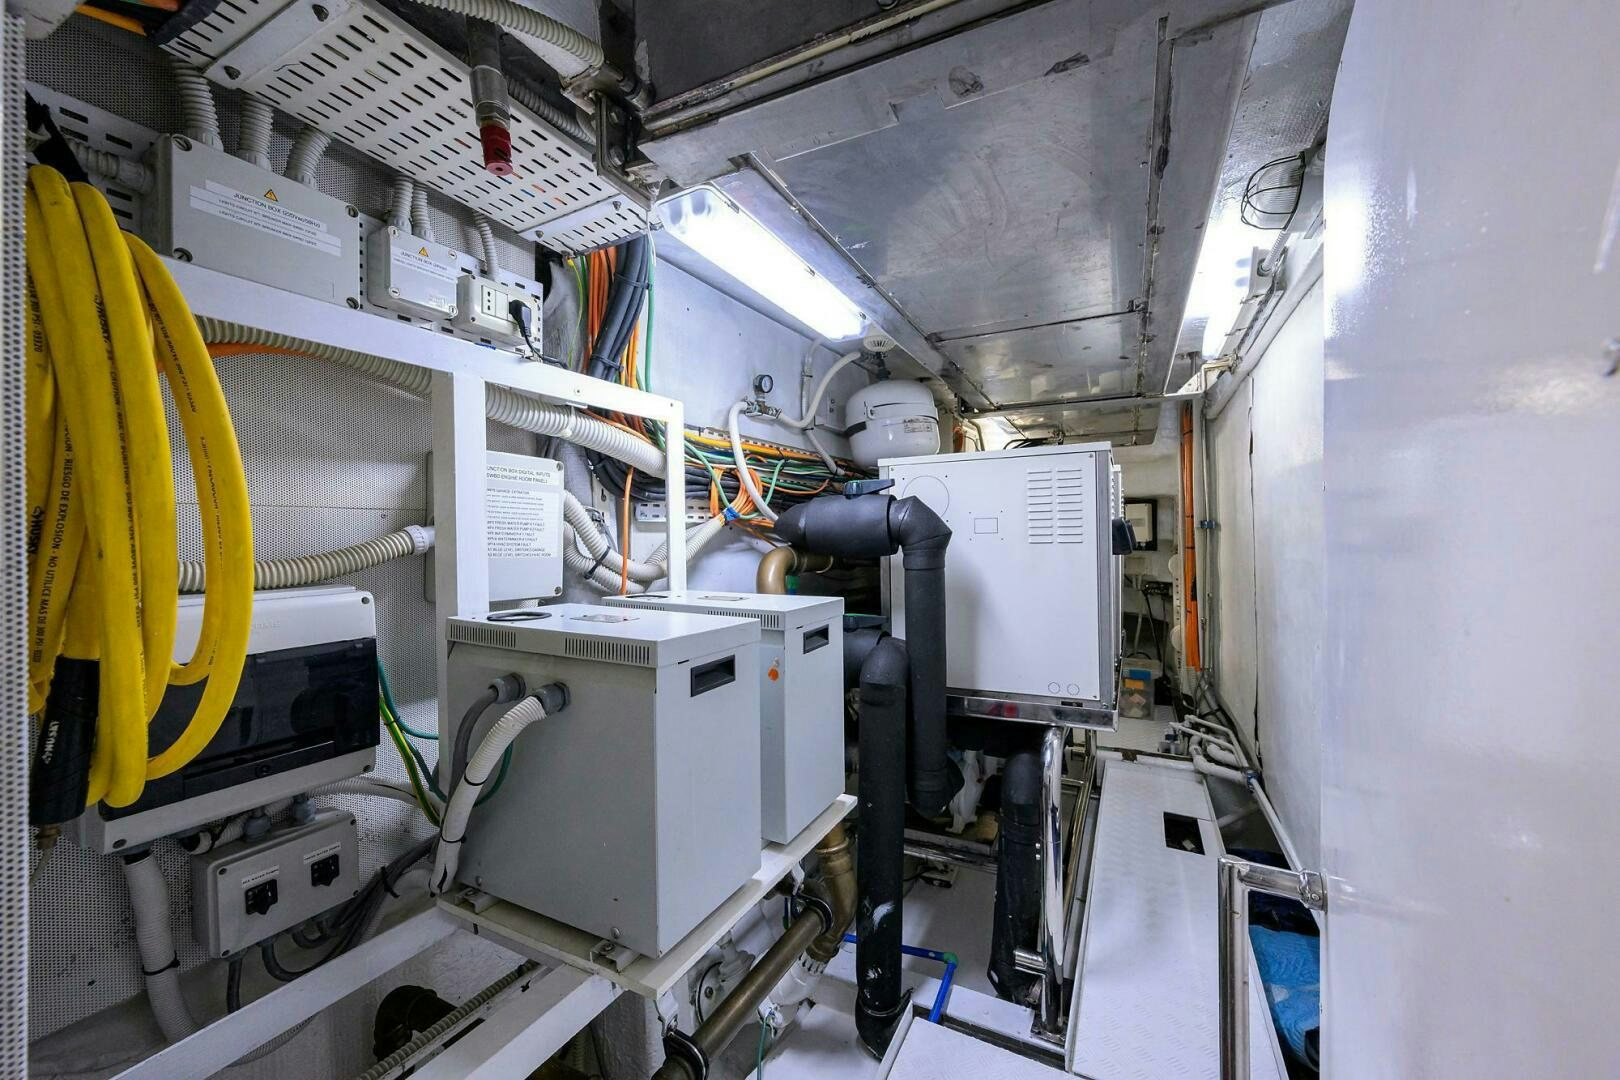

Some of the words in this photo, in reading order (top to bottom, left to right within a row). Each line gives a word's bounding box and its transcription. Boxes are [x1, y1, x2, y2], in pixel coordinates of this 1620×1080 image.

[233, 193, 267, 209] JUNCTION
[268, 204, 281, 213] BOX
[401, 251, 423, 262] JUNCTION
[62, 458, 73, 489] RIESGO
[61, 490, 70, 501] DE
[28, 517, 44, 555] HUSKY
[48, 555, 59, 569] NO
[42, 569, 57, 598] UTILICE
